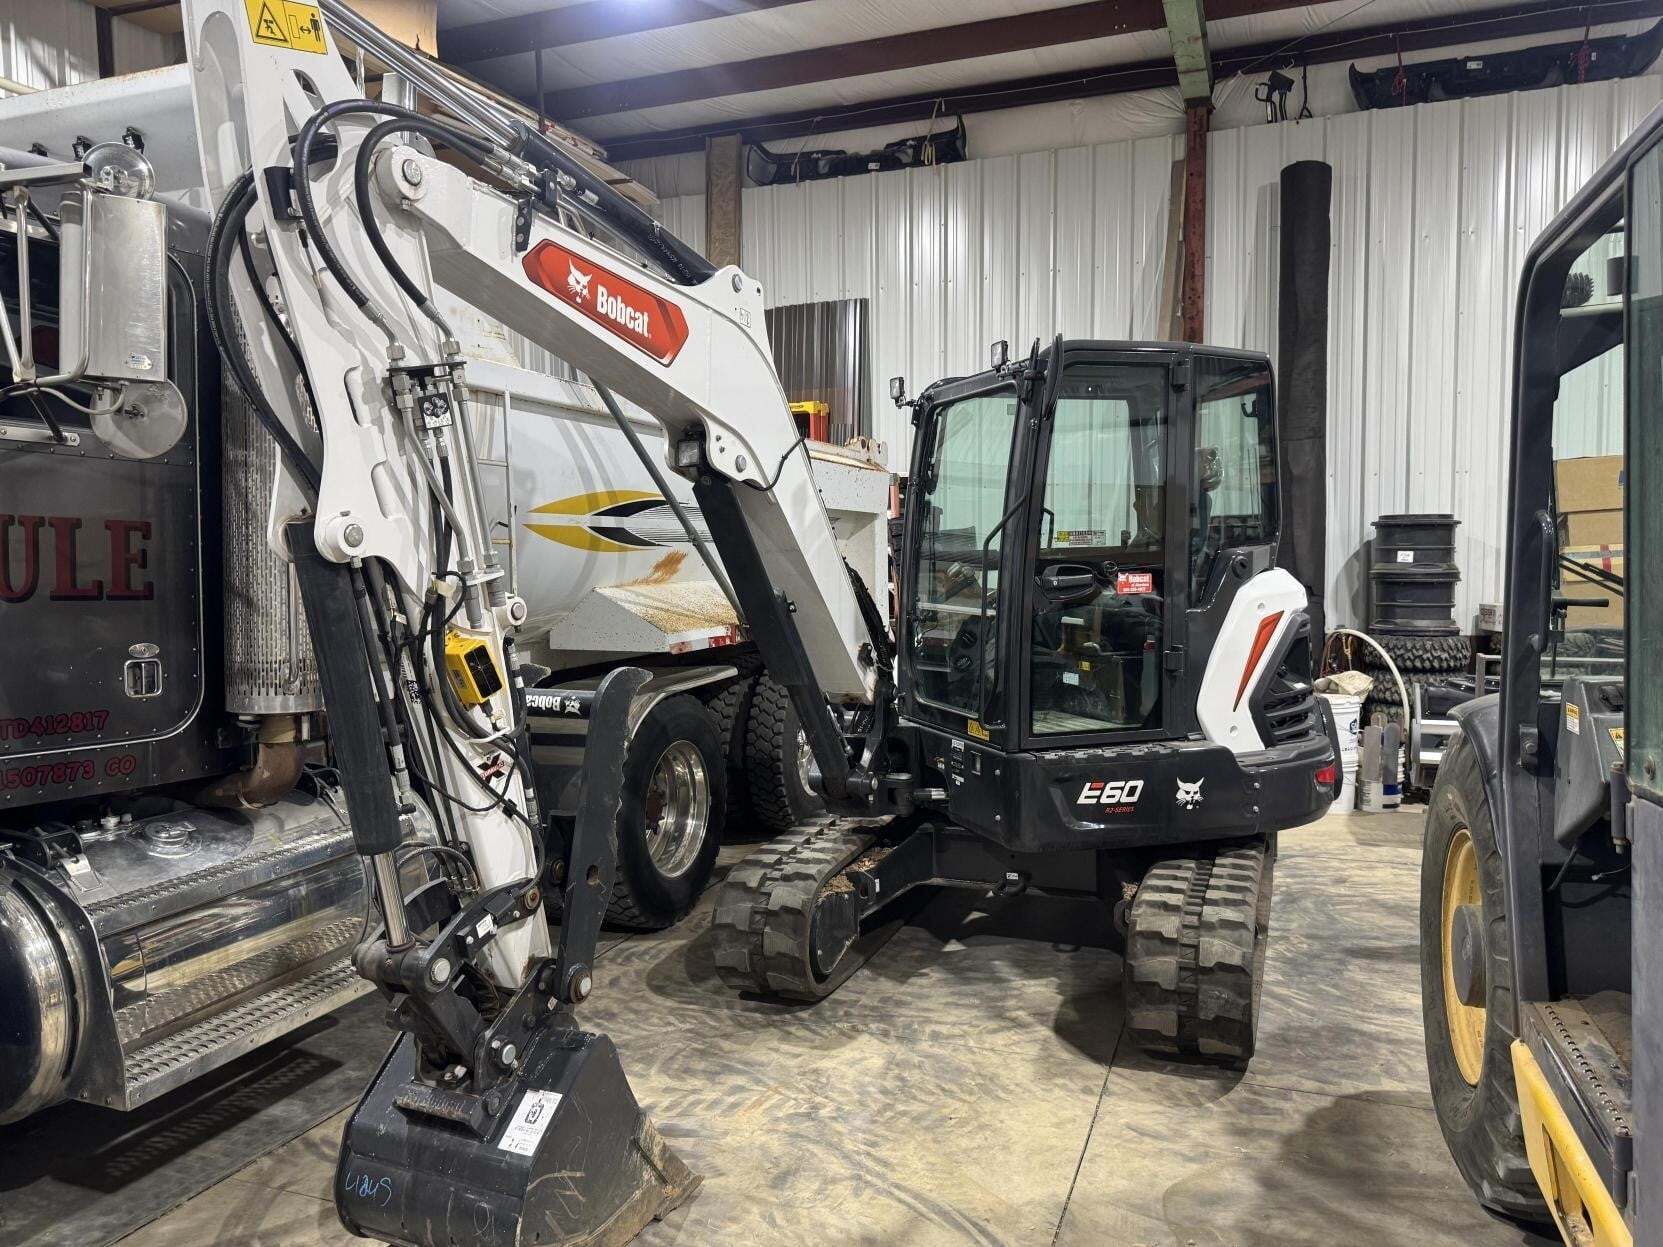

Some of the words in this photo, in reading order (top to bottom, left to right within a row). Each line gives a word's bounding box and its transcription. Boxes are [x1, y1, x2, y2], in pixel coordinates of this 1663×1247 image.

[596, 283, 650, 337] Bobcat
[0, 513, 155, 604] ULE
[526, 694, 561, 712] Bobca
[105, 754, 137, 777] CO
[1076, 779, 1144, 805] E60
